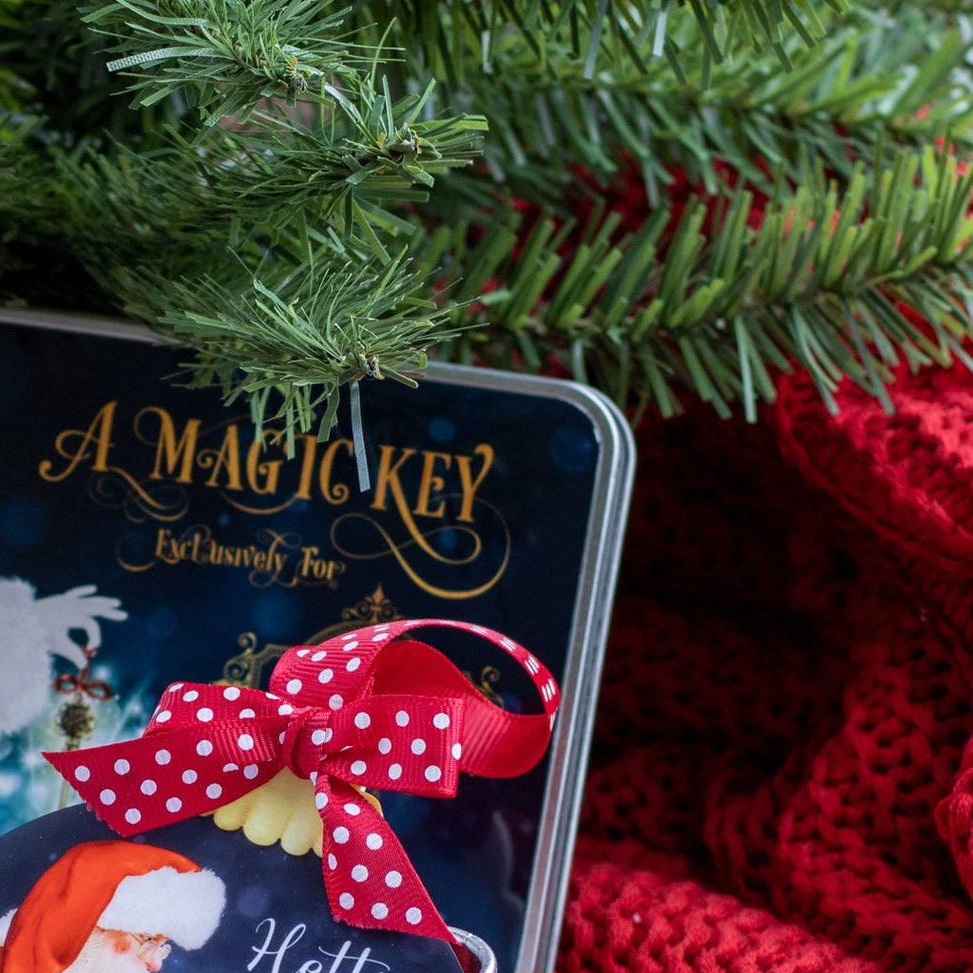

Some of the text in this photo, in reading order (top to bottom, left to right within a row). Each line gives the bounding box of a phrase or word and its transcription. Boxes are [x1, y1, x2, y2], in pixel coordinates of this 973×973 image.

[39, 401, 497, 560] A MAGIC KEY
[297, 546, 345, 584] For
